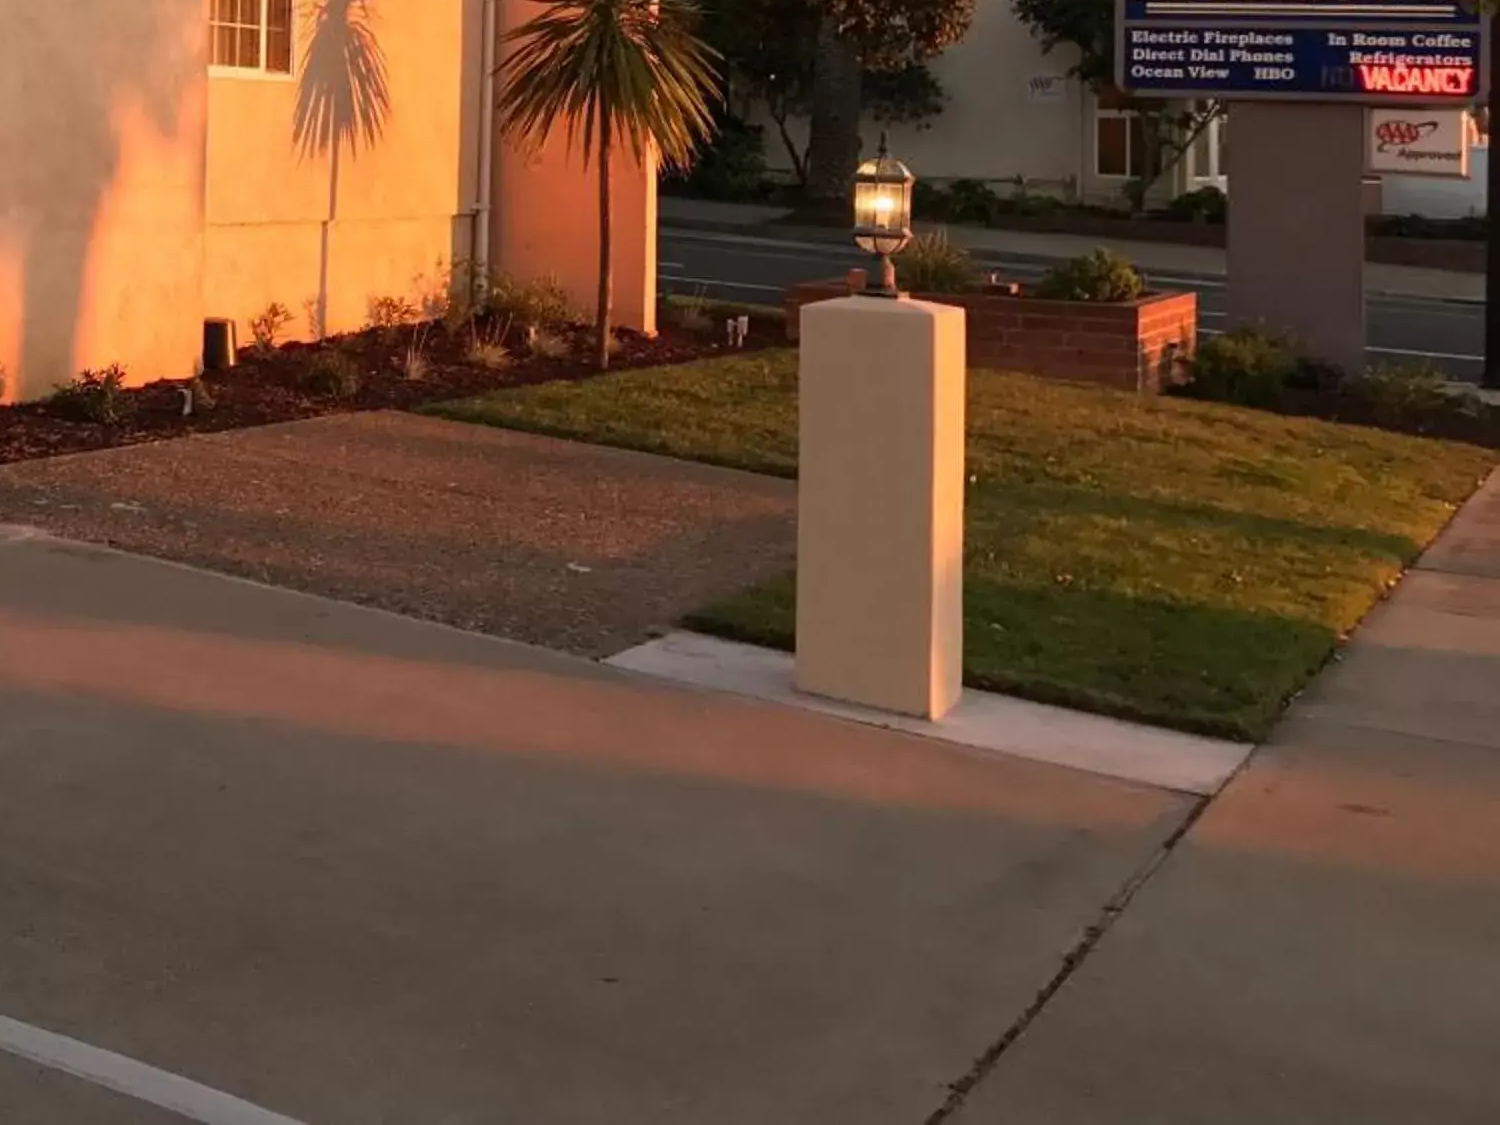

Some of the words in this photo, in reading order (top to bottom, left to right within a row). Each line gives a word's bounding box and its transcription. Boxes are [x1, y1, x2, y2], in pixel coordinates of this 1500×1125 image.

[1131, 30, 1199, 45] Electric
[1203, 31, 1294, 48] Fireplaces
[1327, 32, 1347, 47] In
[1352, 33, 1406, 47] Room
[1412, 34, 1472, 48] Coffee
[1132, 48, 1186, 62] Direct
[1190, 49, 1225, 63] Dial
[1229, 49, 1294, 64] Phones
[1349, 51, 1473, 68] Refrigerators
[1131, 65, 1184, 79] Ocean
[1187, 66, 1230, 79] View
[1254, 67, 1295, 81] HBO
[1360, 65, 1474, 94] VACANCY
